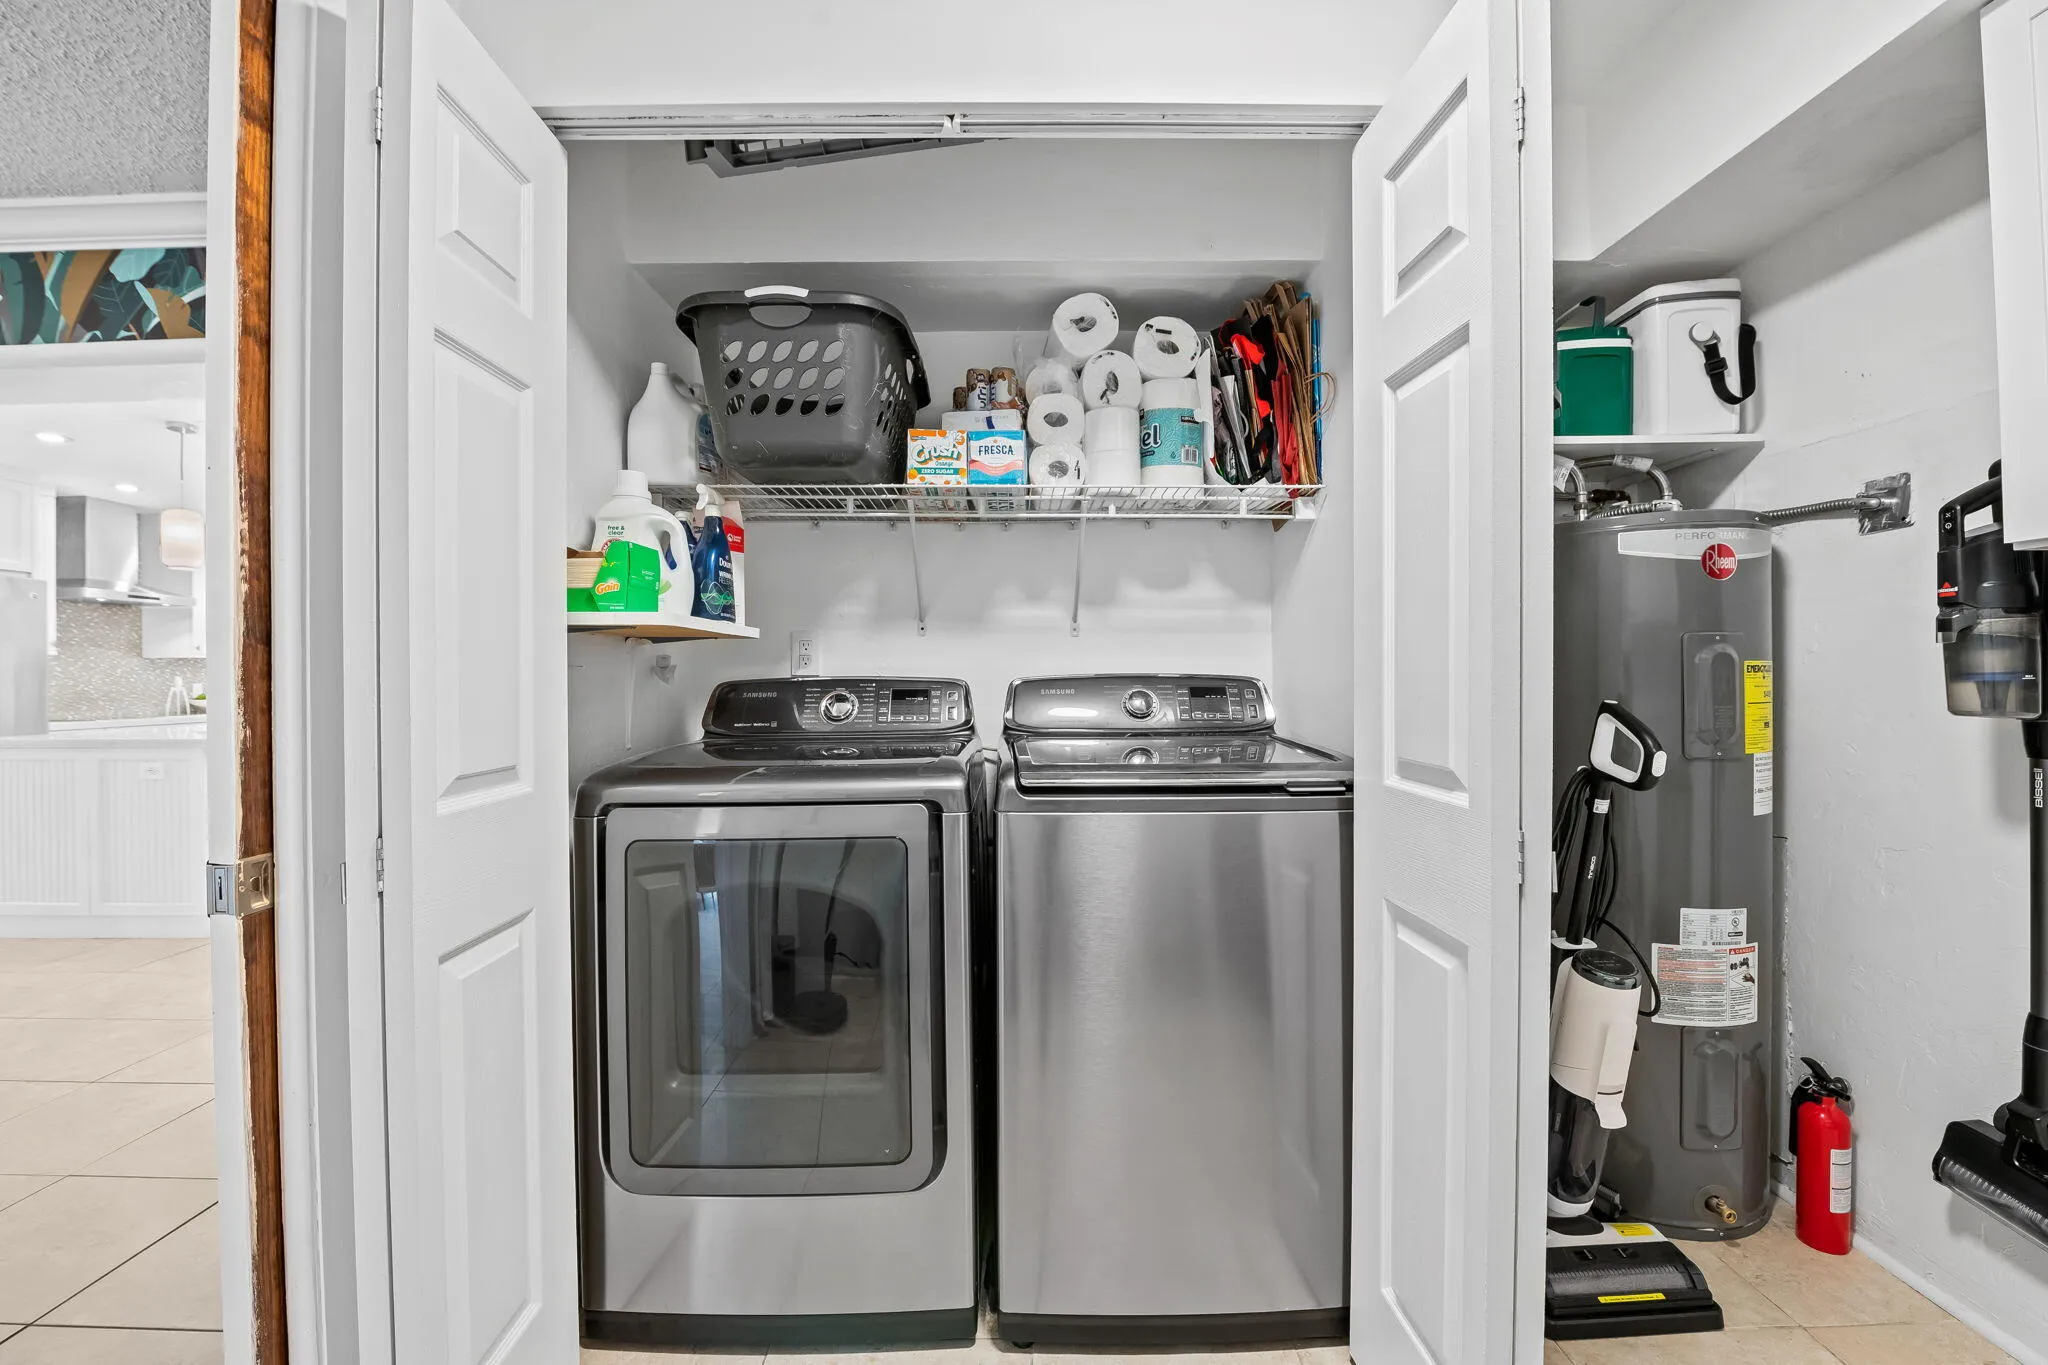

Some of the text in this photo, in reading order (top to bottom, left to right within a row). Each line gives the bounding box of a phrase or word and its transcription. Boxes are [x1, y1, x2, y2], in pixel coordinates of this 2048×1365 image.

[911, 441, 963, 465] Crush
[978, 445, 1014, 456] FRESCA
[1706, 544, 1735, 574] Rheem
[596, 583, 620, 595] Gain
